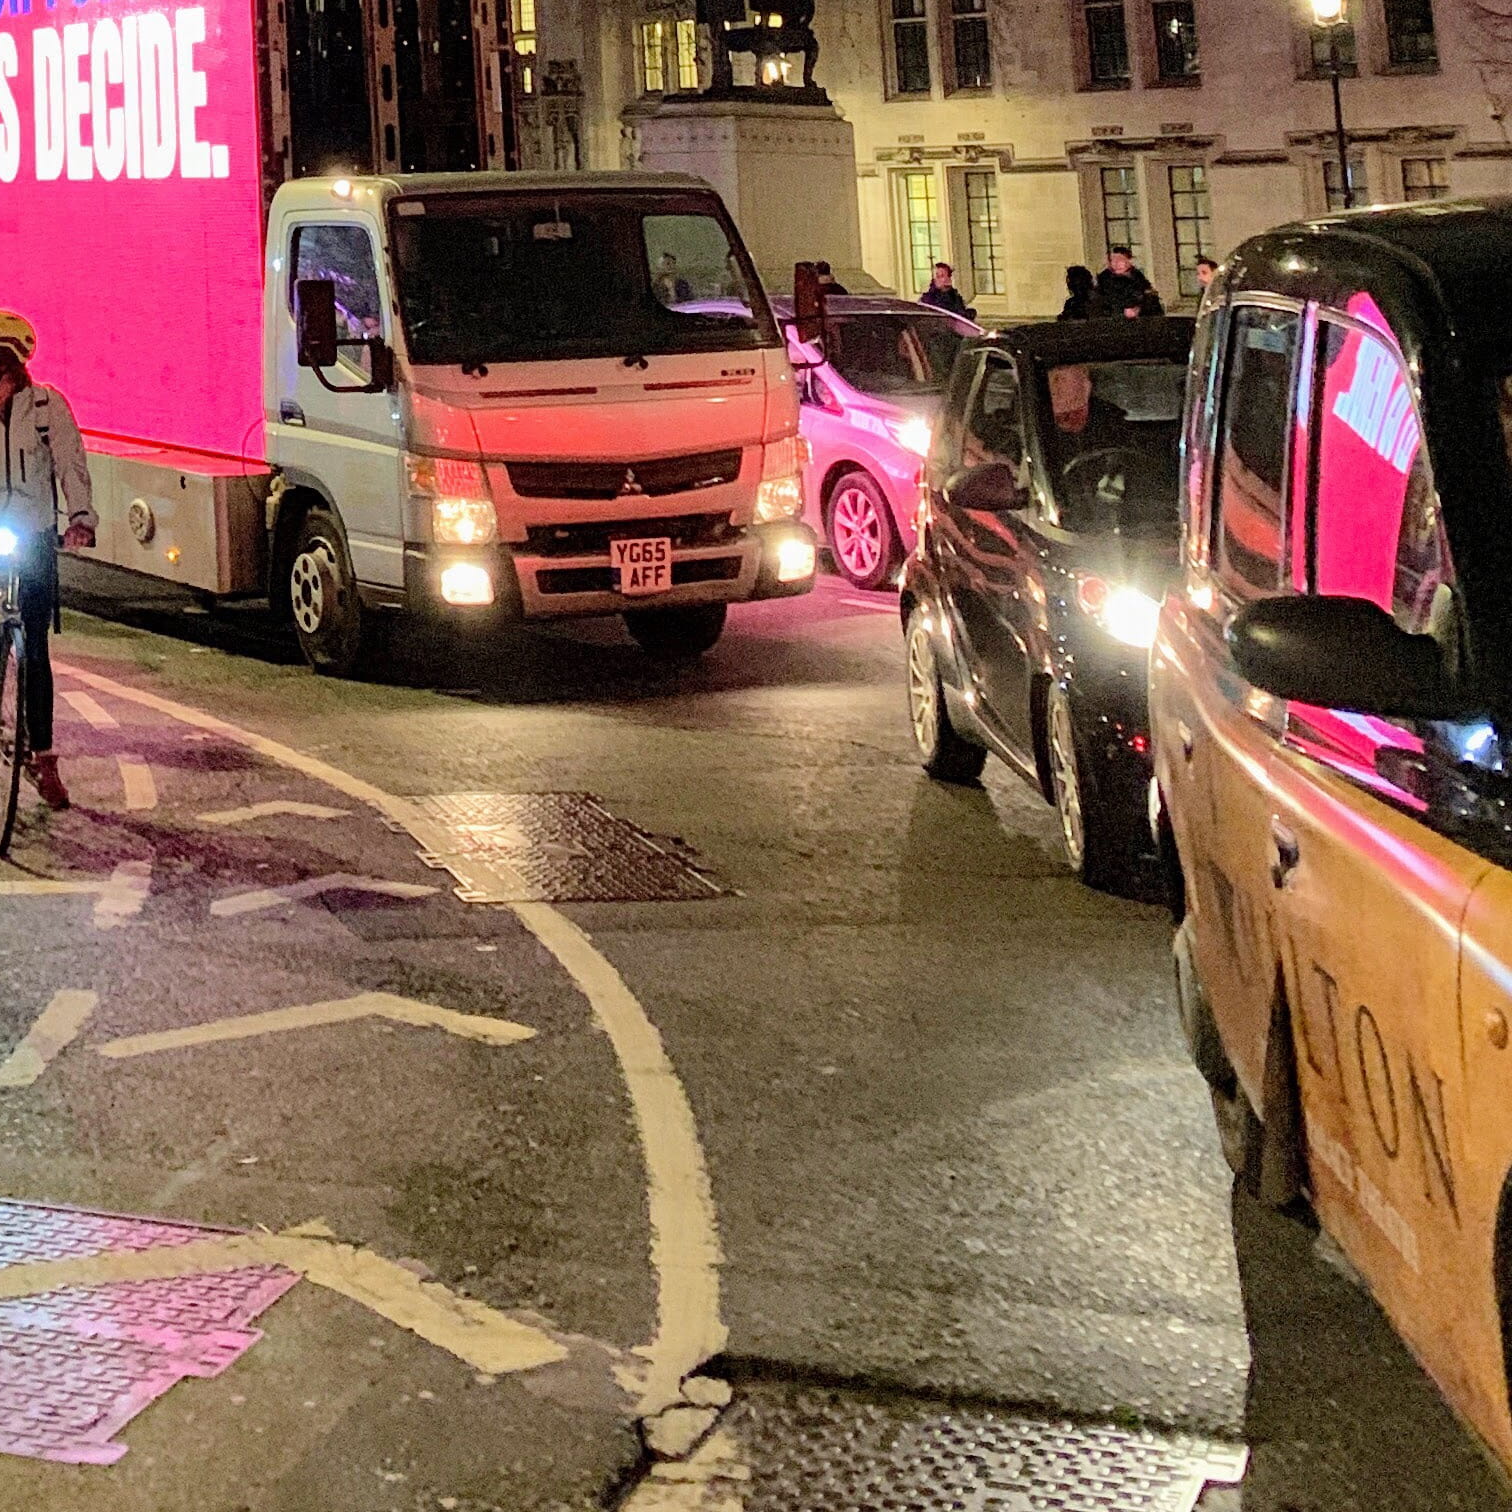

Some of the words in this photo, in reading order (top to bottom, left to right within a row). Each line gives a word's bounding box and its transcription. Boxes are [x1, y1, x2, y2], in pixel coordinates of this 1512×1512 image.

[32, 7, 230, 181] DECIDE.
[616, 541, 665, 564] YG65
[630, 565, 666, 588] AFF
